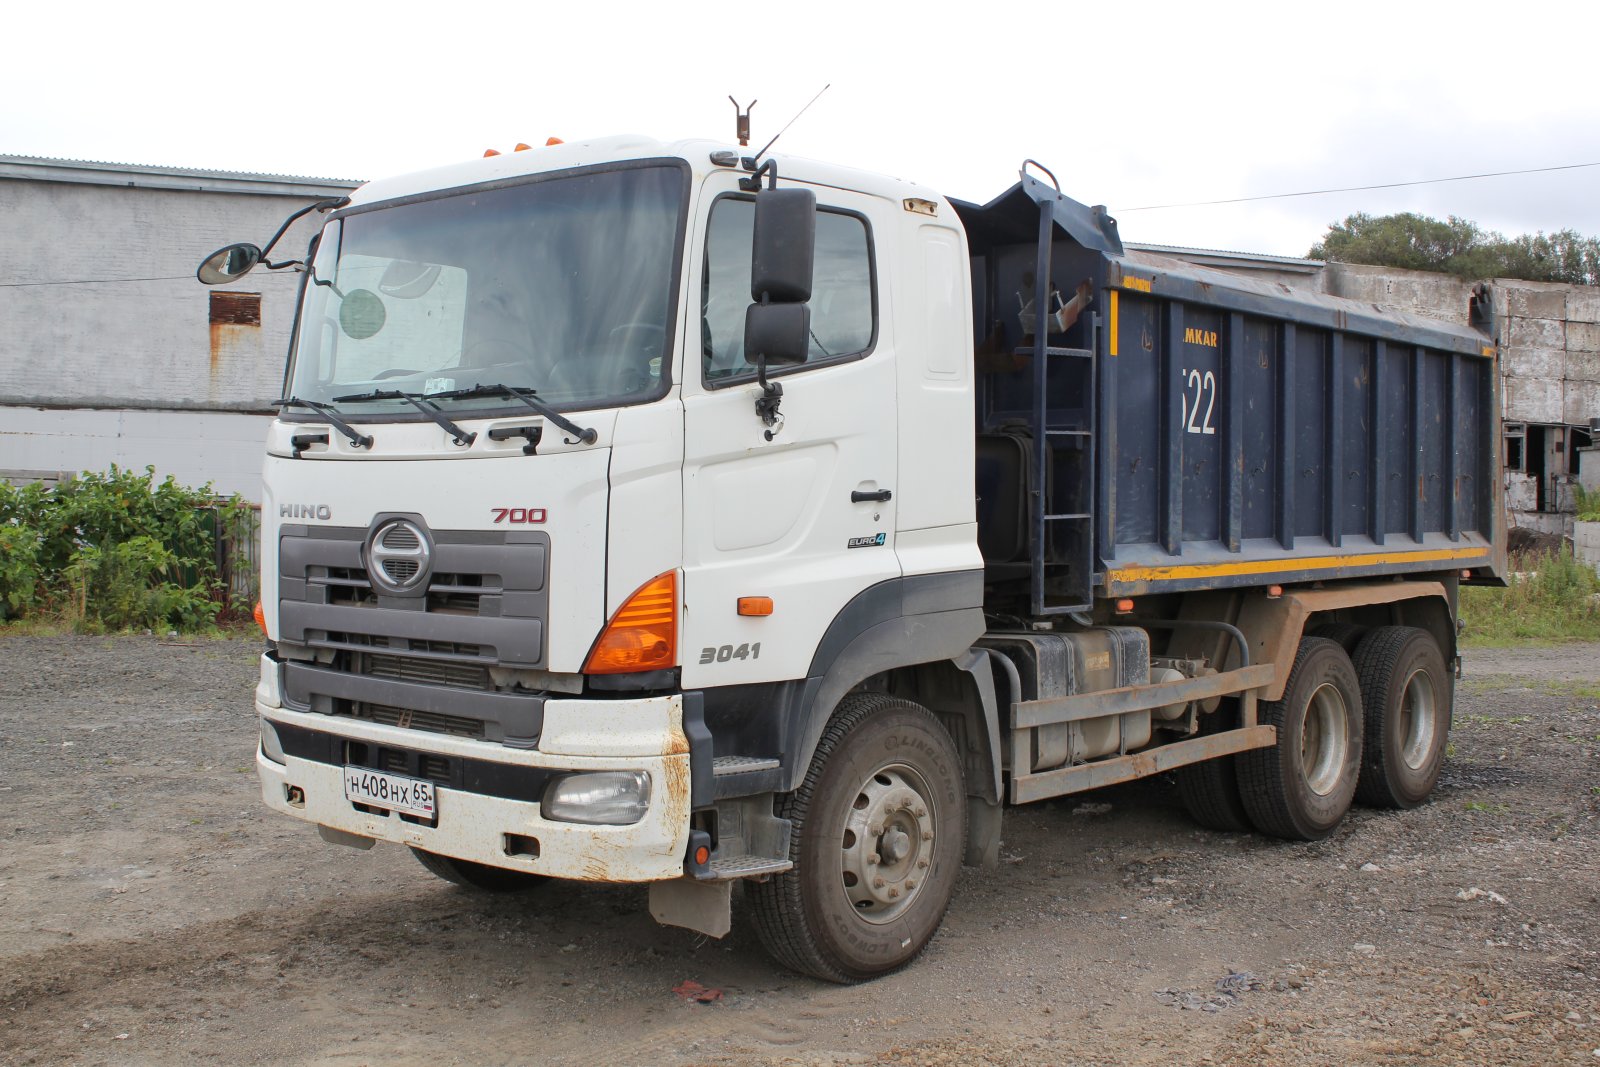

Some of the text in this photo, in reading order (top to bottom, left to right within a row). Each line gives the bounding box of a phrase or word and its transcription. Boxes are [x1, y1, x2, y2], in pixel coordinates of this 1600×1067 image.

[1183, 327, 1217, 347] MKAR
[280, 503, 331, 520] HINO
[491, 508, 548, 524] 700
[699, 642, 761, 664] 3041
[413, 783, 428, 802] 65
[412, 800, 424, 808] RUS
